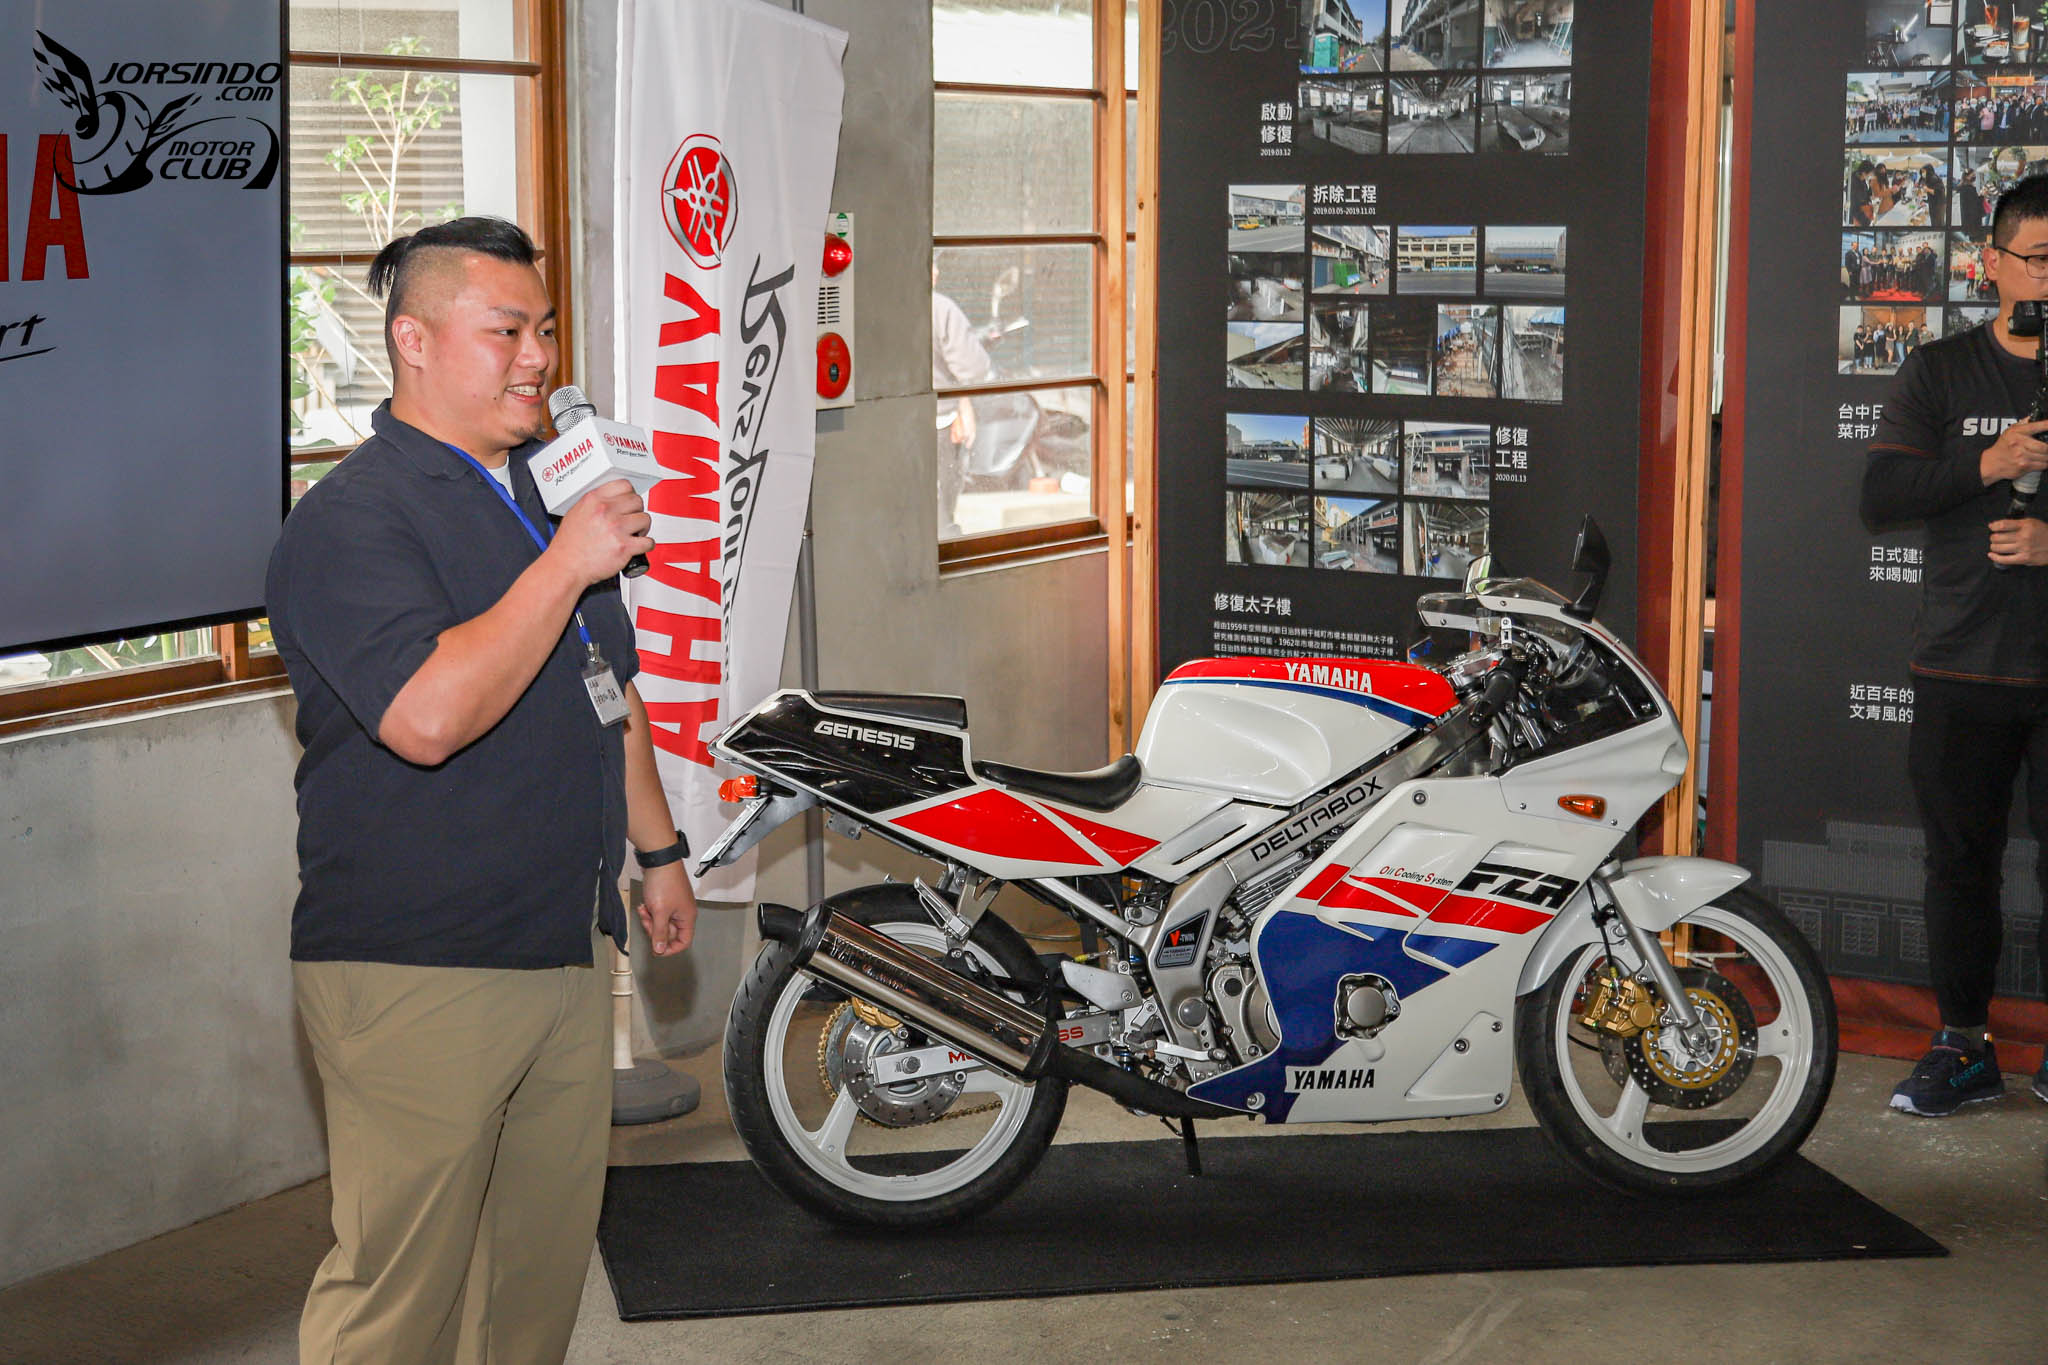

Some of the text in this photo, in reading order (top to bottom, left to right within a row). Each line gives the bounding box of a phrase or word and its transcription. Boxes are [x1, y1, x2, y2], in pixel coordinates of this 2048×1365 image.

[1261, 125, 1293, 143] 修復
[1313, 184, 1377, 204] 拆除工程
[0, 134, 89, 281] A
[613, 435, 648, 453] YAMAHA
[1495, 426, 1528, 446] 修復
[552, 439, 594, 474] YAMAHA
[1495, 449, 1528, 469] 工程
[1871, 546, 1923, 564] 日式建
[1869, 565, 1922, 583] 來喝咖
[1214, 592, 1292, 616] 修復太子樓
[1285, 662, 1373, 695] YAMAHA
[1850, 684, 1914, 704] 近百年的
[1849, 703, 1914, 723] 文青風的
[814, 720, 916, 751] GENESIS
[1250, 775, 1384, 863] DELTABOX
[1394, 867, 1424, 882] Cooling
[1424, 873, 1454, 886] System
[1456, 862, 1580, 909] FZR
[1294, 1069, 1375, 1091] YAMAHA
